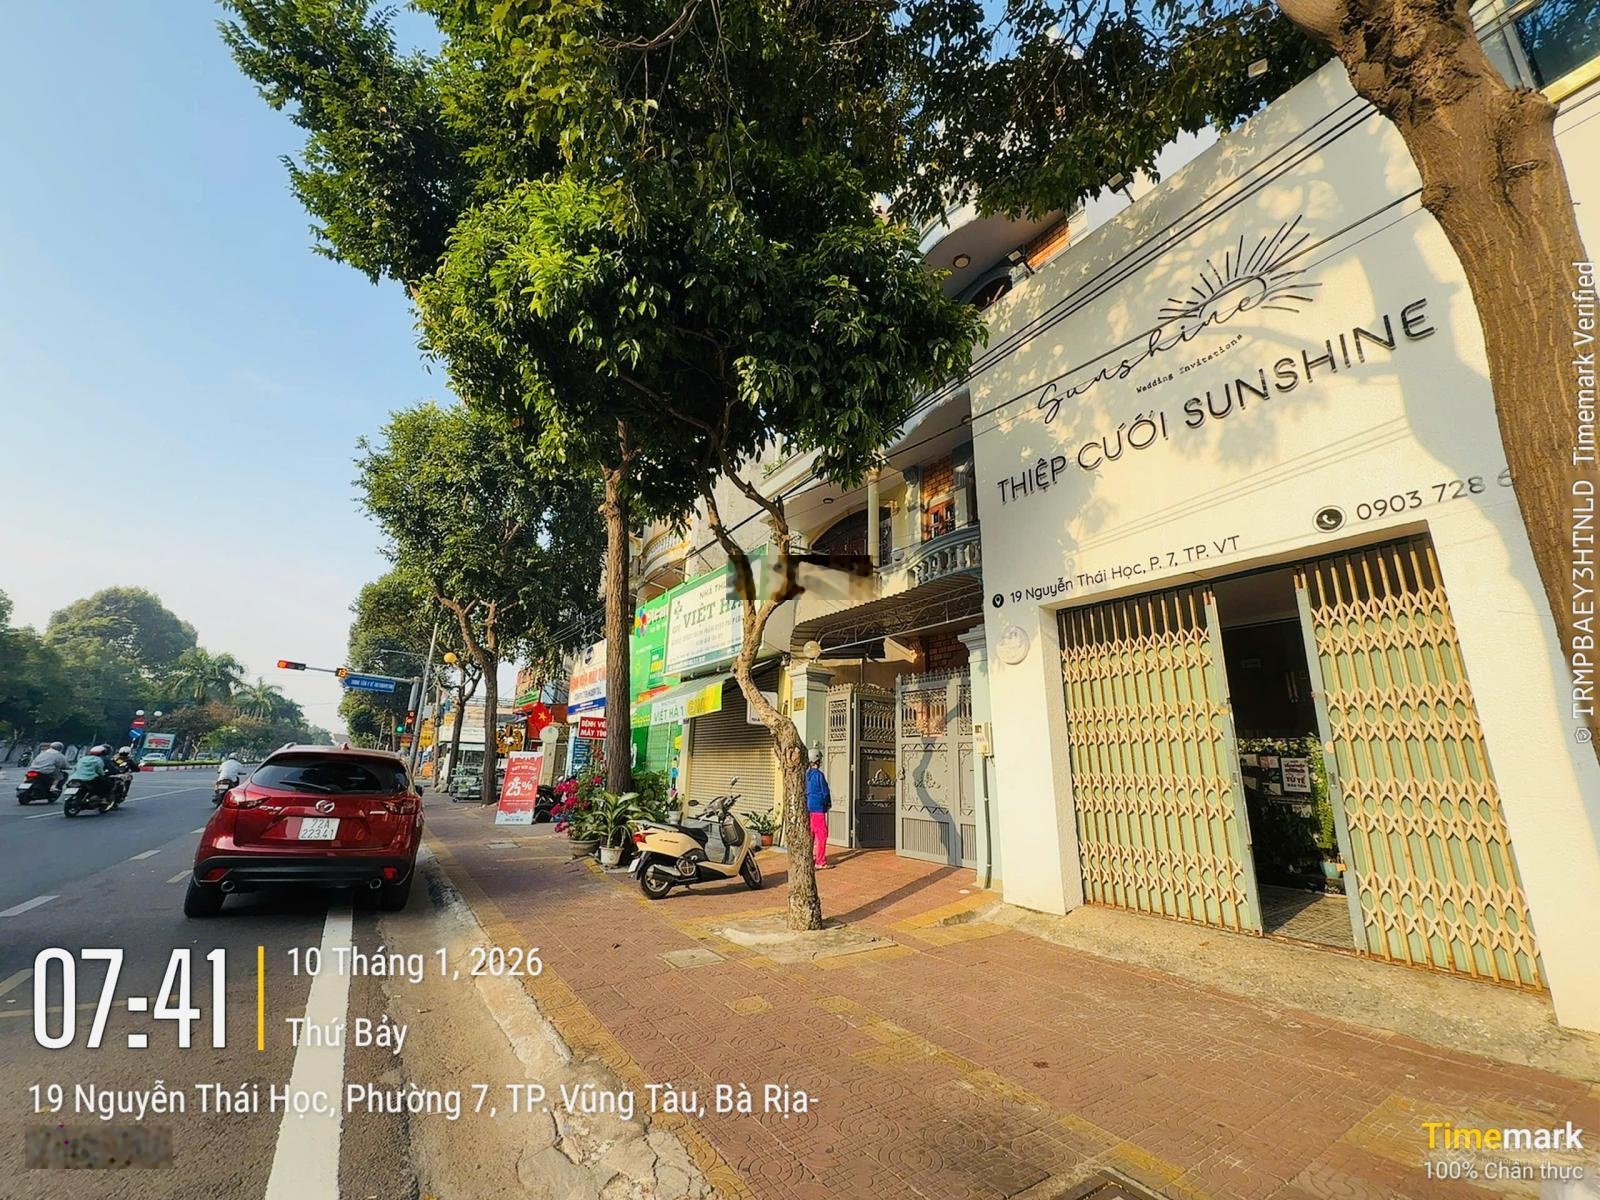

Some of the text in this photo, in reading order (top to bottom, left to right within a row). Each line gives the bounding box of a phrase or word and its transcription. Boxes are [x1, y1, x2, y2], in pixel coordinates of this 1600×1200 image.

[1038, 284, 1264, 424] Sunshine
[1136, 333, 1243, 394] Wedding Invitations
[997, 298, 1438, 504] THIỆP CƯỚI SUNSHINE
[1356, 490, 1422, 521] 0903
[1432, 476, 1486, 503] 728
[1010, 535, 1240, 604] 19 Nguyễn Thái Học, P. 7, TP. VT
[311, 818, 330, 829] 72A
